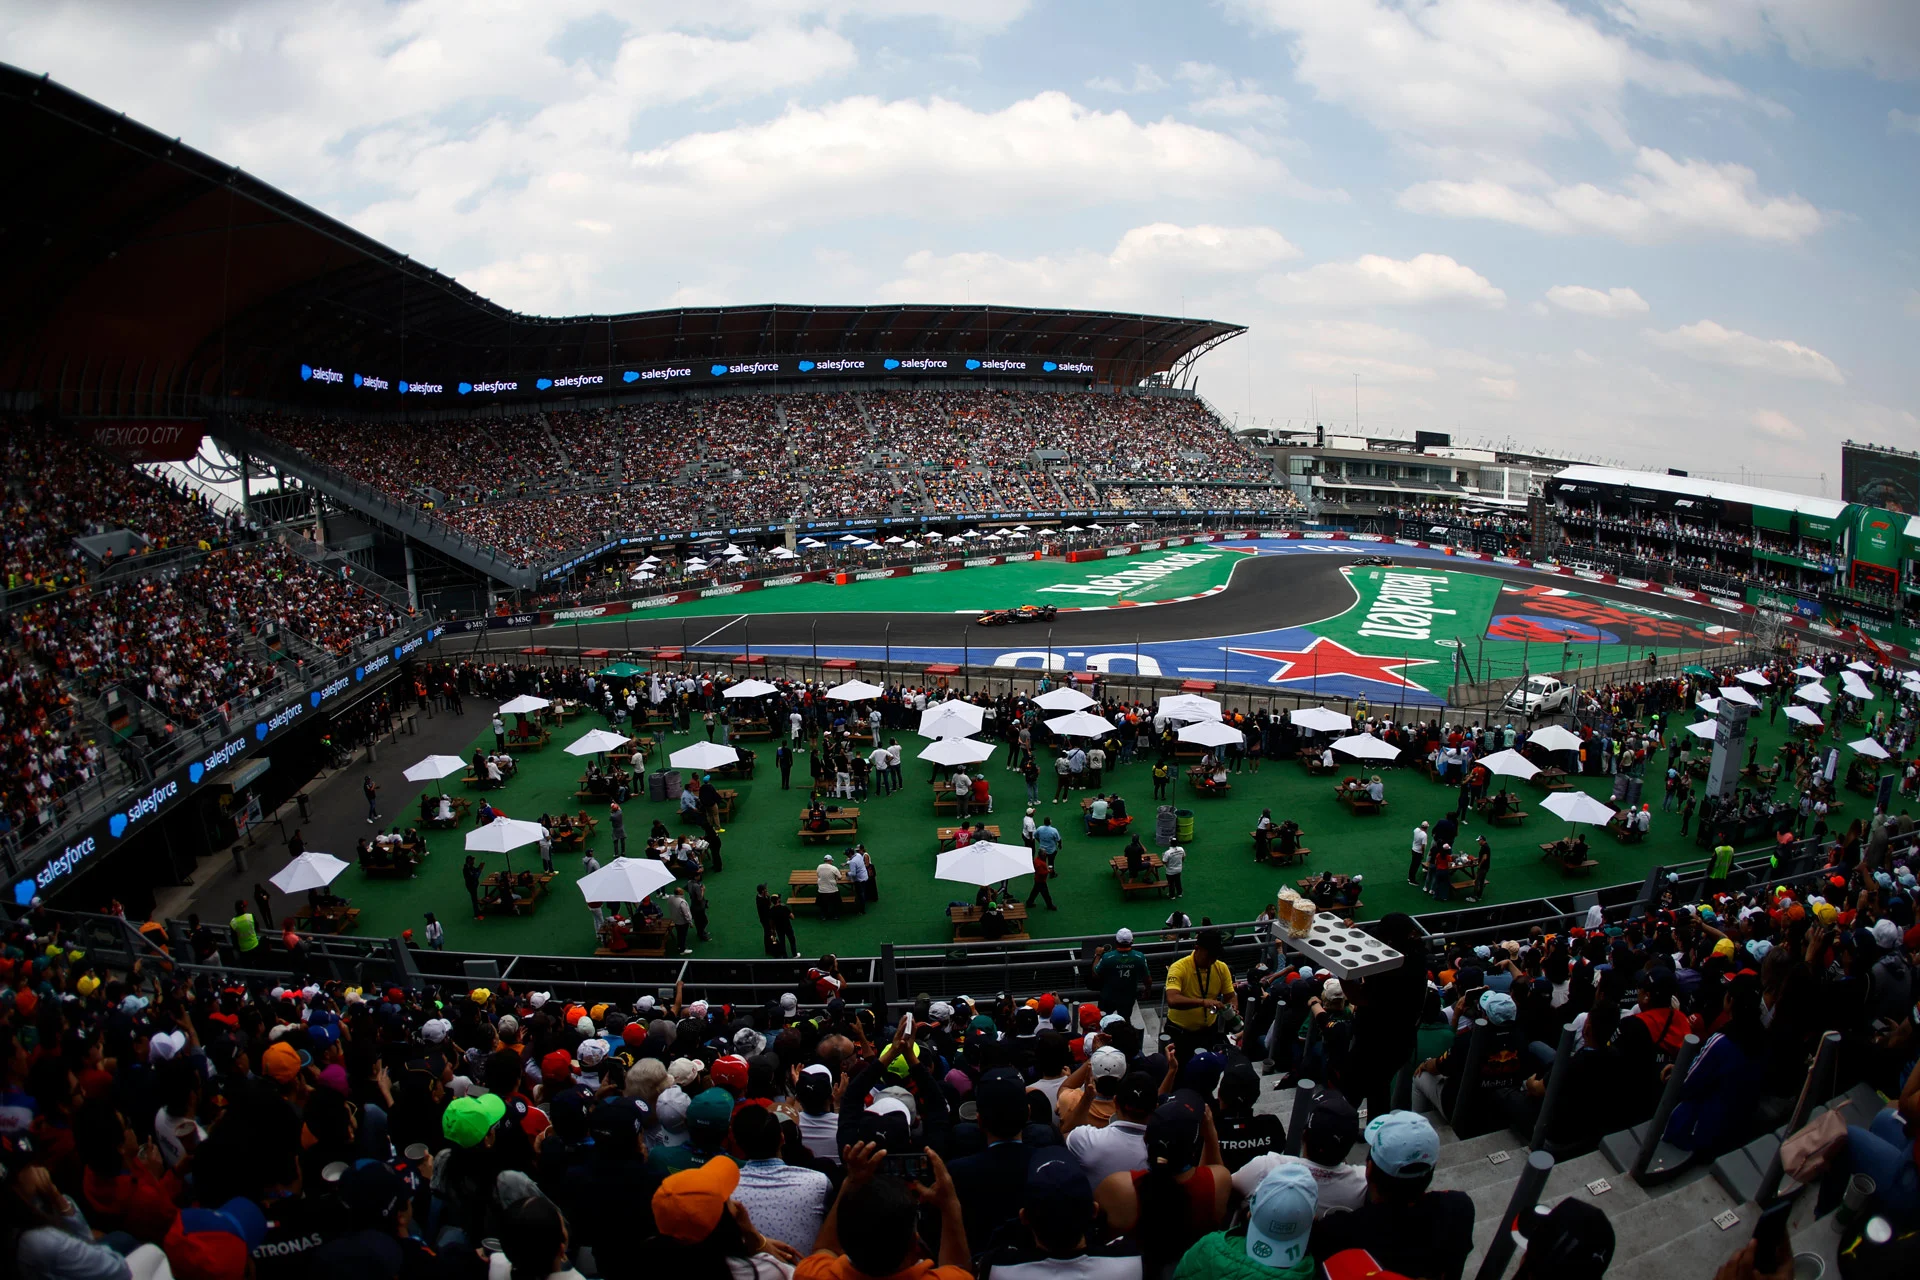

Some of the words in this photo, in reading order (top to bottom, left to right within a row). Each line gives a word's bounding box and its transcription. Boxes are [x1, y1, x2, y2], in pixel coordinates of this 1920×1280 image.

[729, 361, 779, 375] salesforce
[817, 360, 865, 372] salesforce
[901, 359, 948, 371] salesforce
[982, 360, 1026, 371] salesforce
[312, 366, 343, 384] salesforce
[554, 374, 604, 388] salesforce
[641, 367, 691, 381] salesforce
[363, 375, 389, 390] salesforce
[408, 381, 442, 395] salesforce
[473, 380, 518, 394] salesforce
[93, 426, 150, 446] MEXICO
[151, 426, 185, 445] CITY
[1563, 518, 1592, 527] WHERE
[1596, 523, 1652, 537] ADRENALINE
[1691, 538, 1738, 552] ELEGANCE
[856, 569, 895, 581] #MexicoGP
[912, 563, 948, 574] #MexicoGP
[763, 575, 803, 588] #MexicoGP
[1618, 577, 1649, 589] #MexicoGP
[700, 584, 743, 598] #MexicoGP
[1664, 586, 1696, 598] #MexicoGP
[631, 595, 679, 610] #MexicoGP
[1357, 572, 1457, 640] Heineken
[1710, 596, 1744, 610] #MexicoGP
[514, 614, 532, 623] MSC
[553, 607, 606, 619] #MexicoGP
[402, 636, 423, 654] salesforce
[364, 654, 389, 675] salesforce
[321, 676, 350, 700] salesforce
[268, 703, 303, 732] salesforce
[205, 737, 246, 772] salesforce
[127, 780, 178, 823] salesforce
[36, 836, 96, 889] salesforce
[1118, 969, 1131, 979] 14
[1218, 1135, 1271, 1150] TRONAS
[1285, 1243, 1300, 1261] 11
